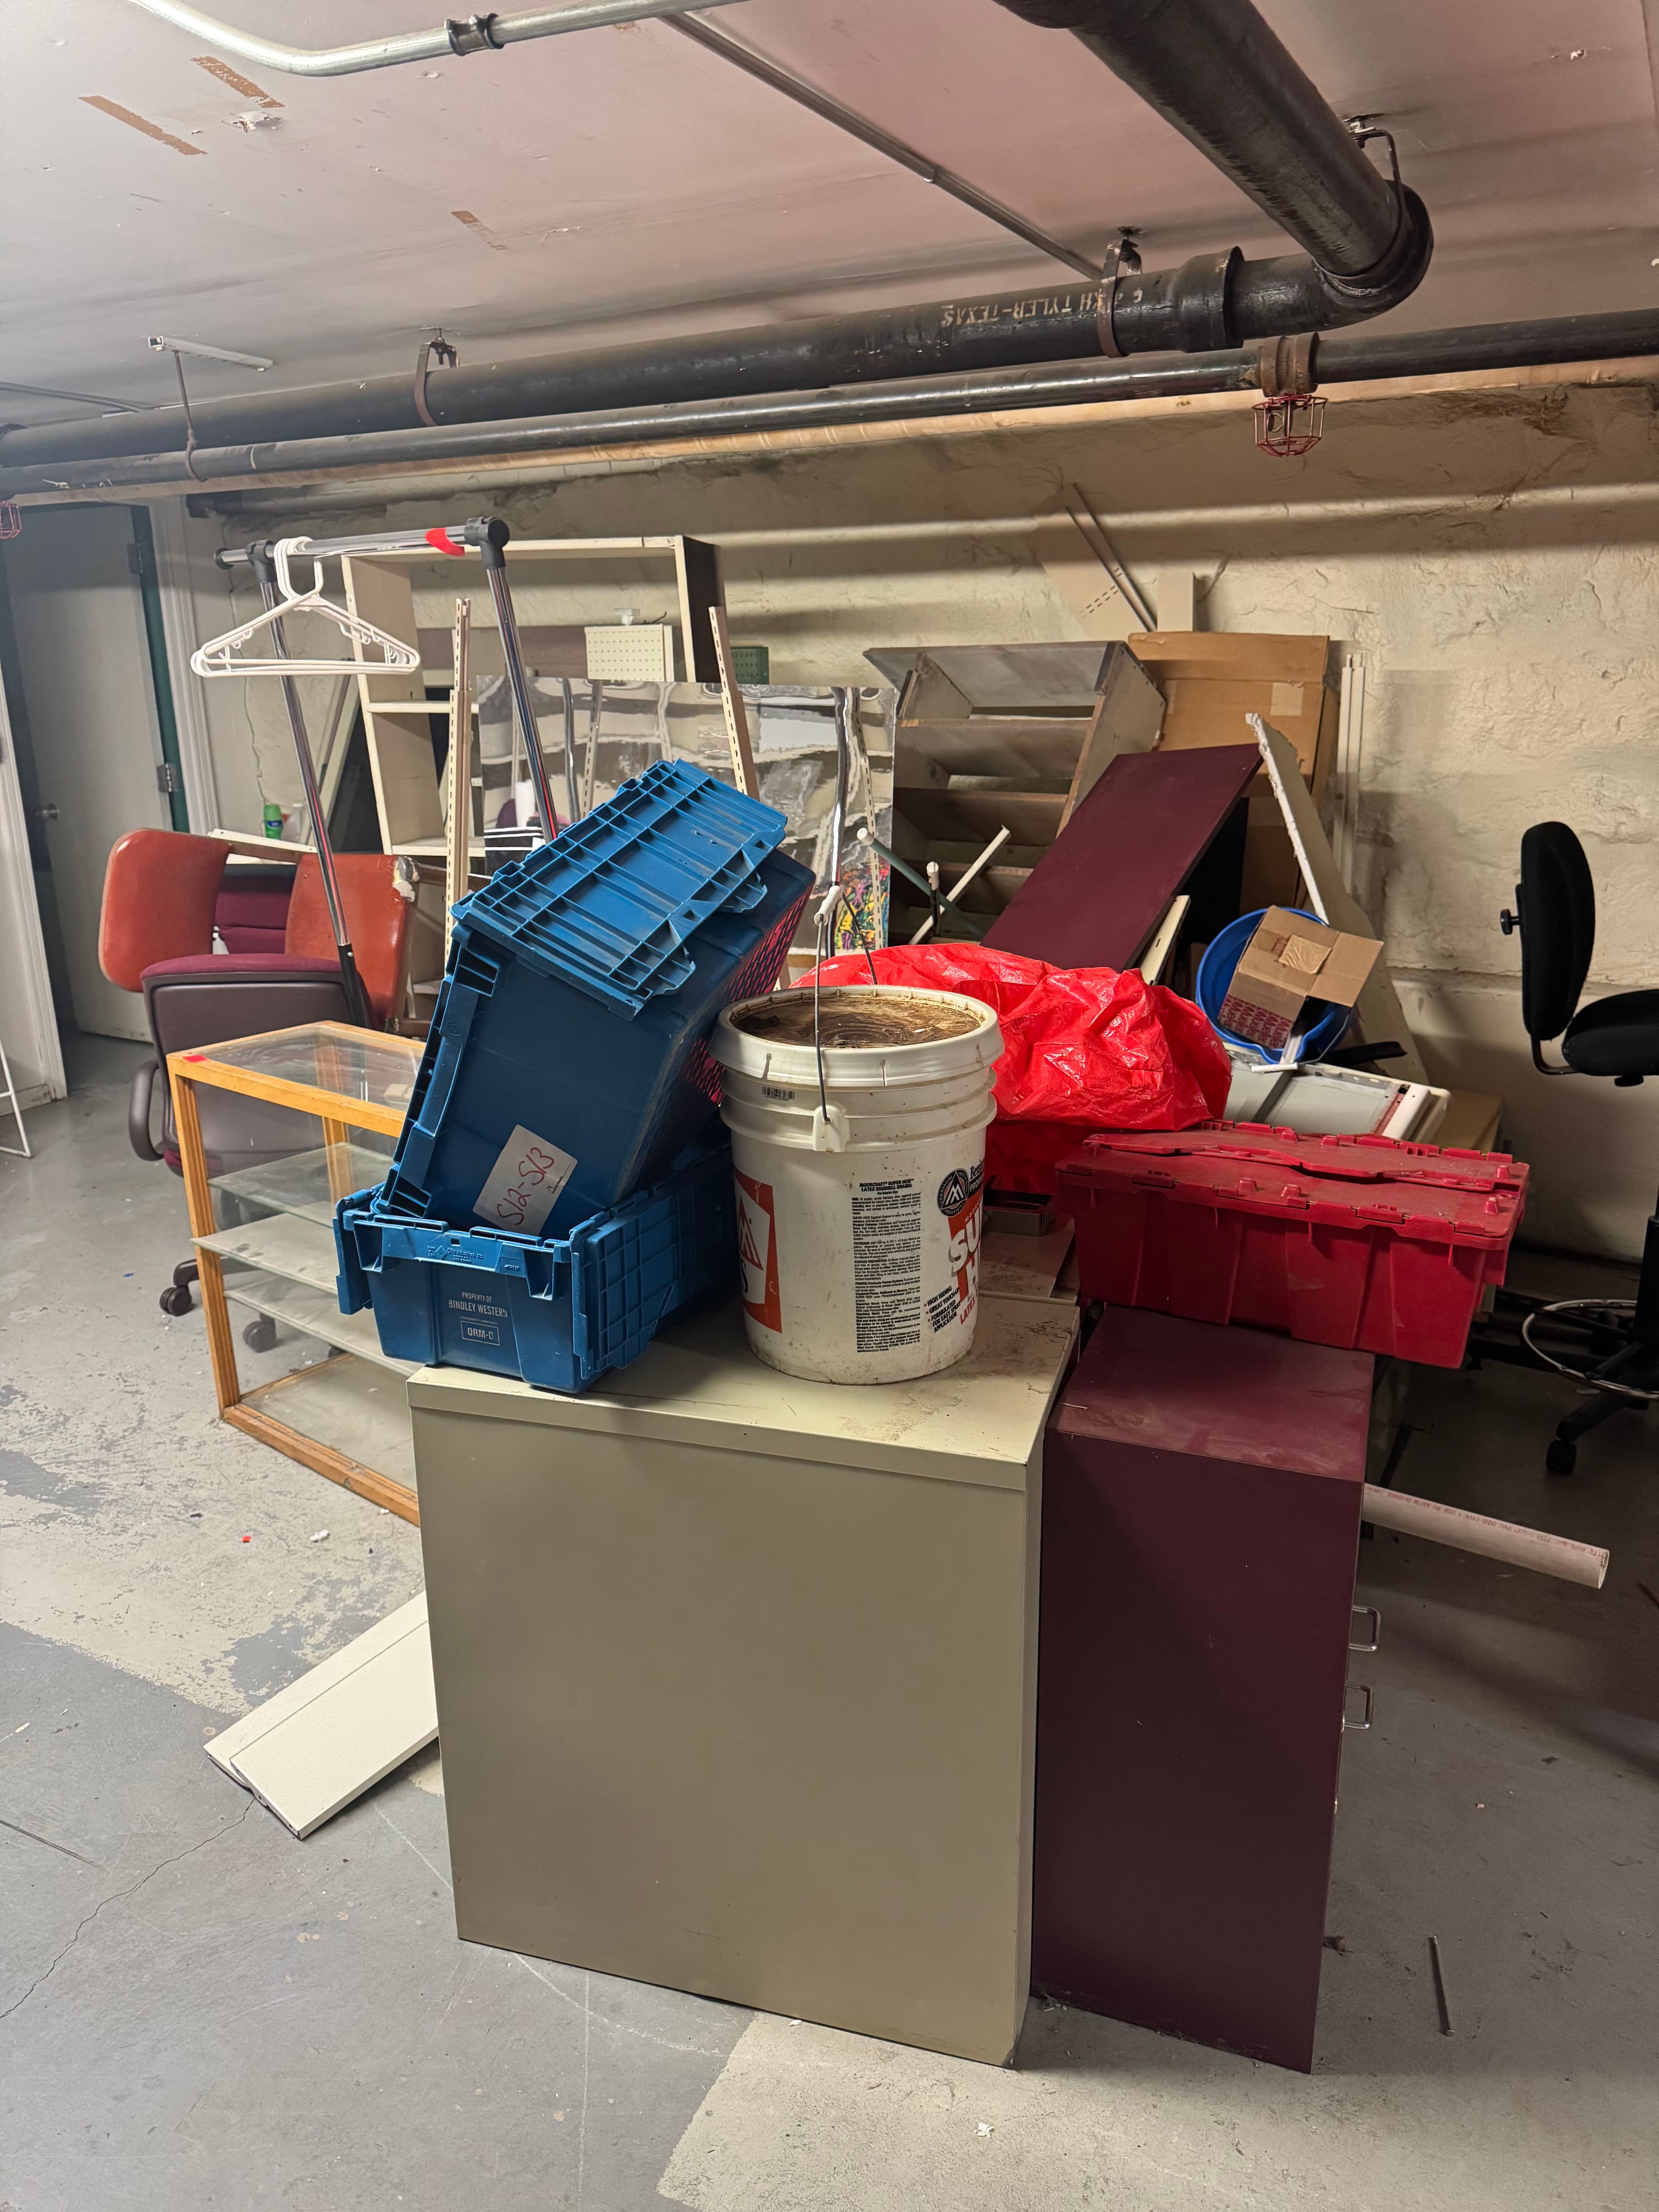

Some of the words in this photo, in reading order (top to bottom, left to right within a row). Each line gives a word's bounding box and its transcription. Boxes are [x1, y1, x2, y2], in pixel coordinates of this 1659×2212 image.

[462, 1292, 485, 1301] PROPERTY
[927, 1295, 938, 1306] HIGH
[938, 1285, 952, 1300] HIDING
[448, 1300, 476, 1312] BINDLEY
[477, 1304, 508, 1318] WESTERN
[929, 1300, 943, 1314] GREAT
[931, 1300, 956, 1321] FORMULATED
[932, 1318, 941, 1327] FOR
[467, 1327, 494, 1340] ORM-D
